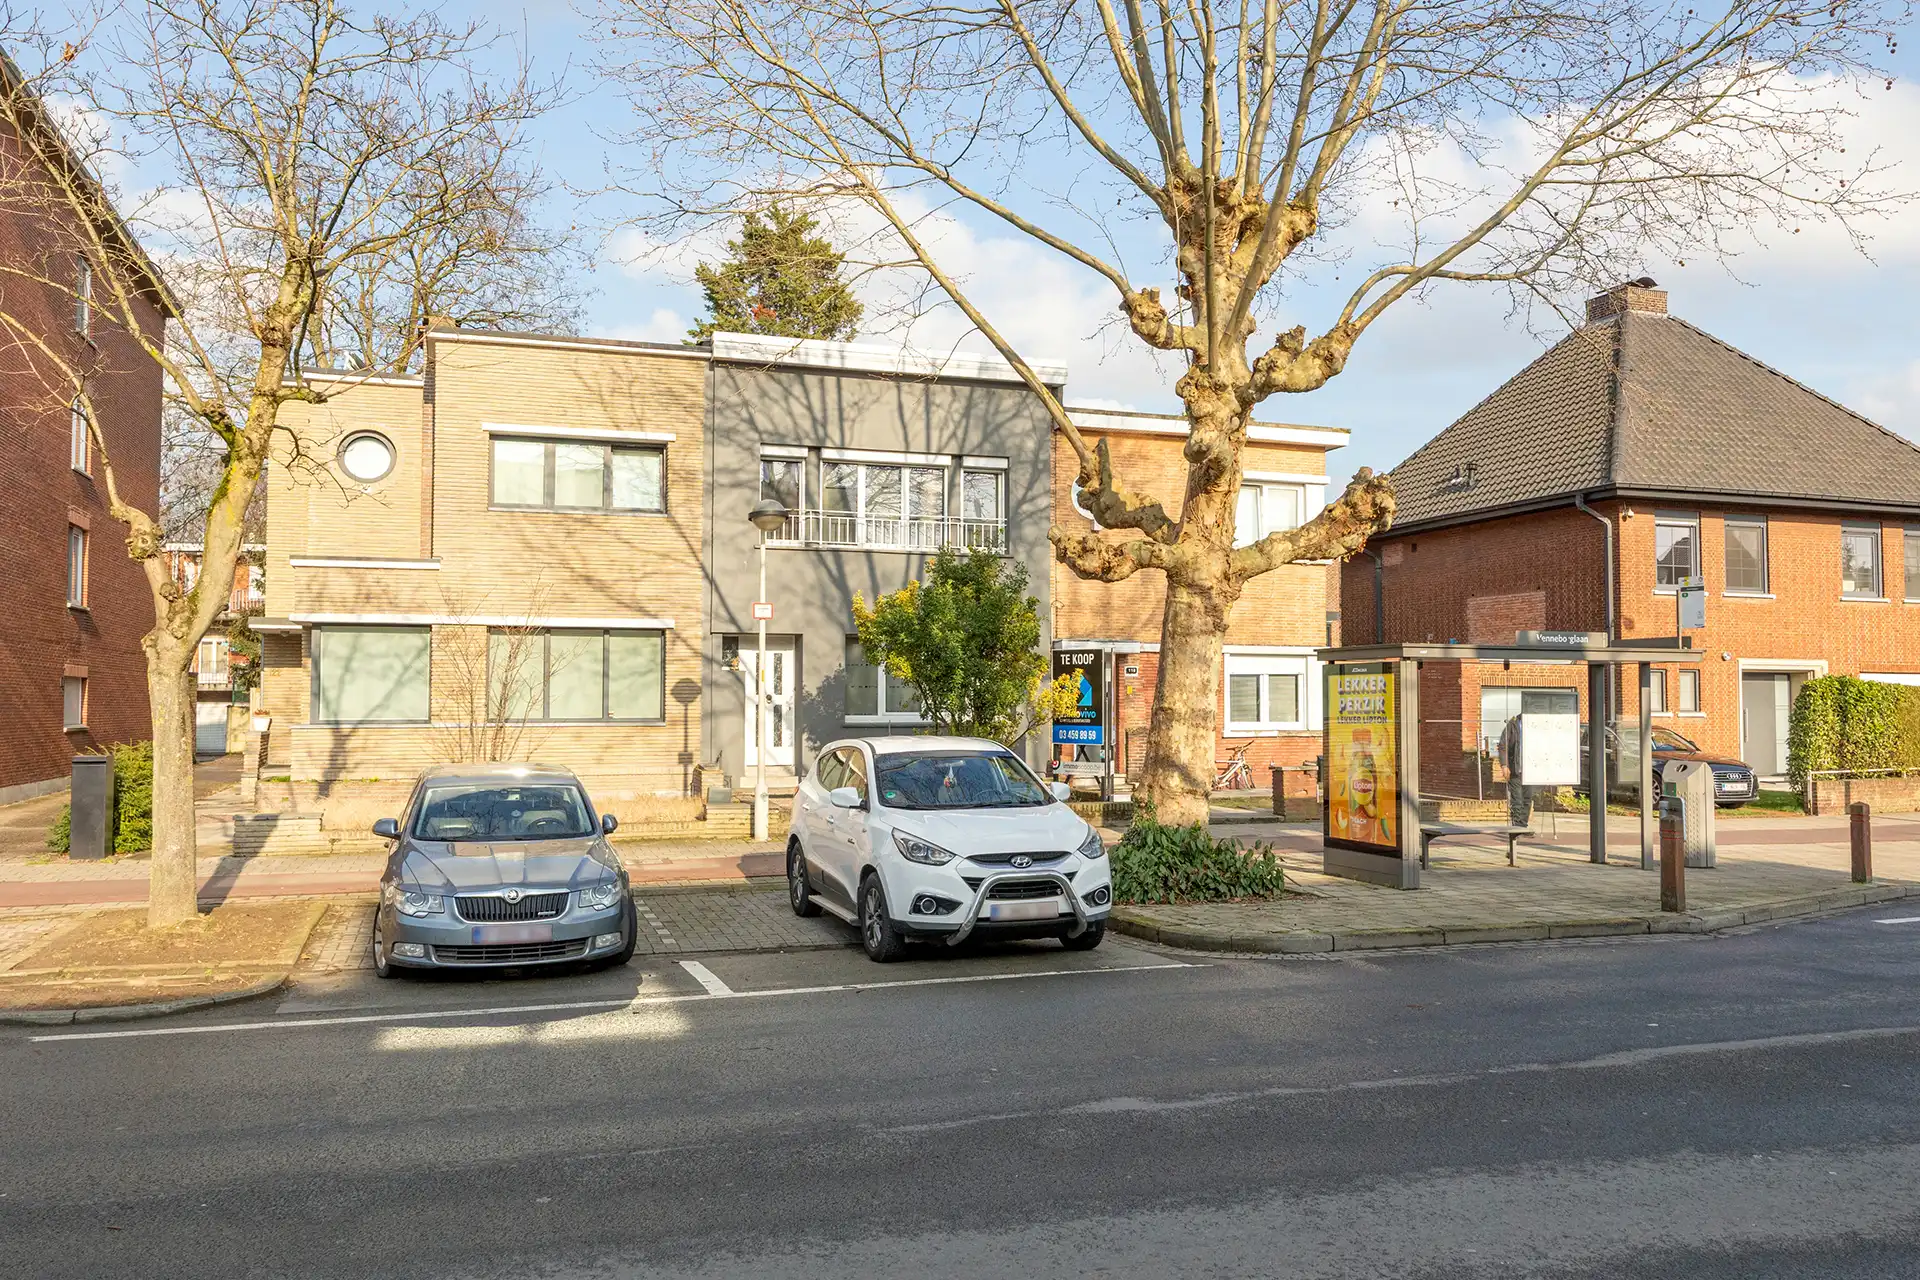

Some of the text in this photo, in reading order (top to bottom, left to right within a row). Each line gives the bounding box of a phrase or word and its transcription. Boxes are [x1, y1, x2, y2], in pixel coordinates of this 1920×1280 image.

[1060, 653, 1095, 665] TE KOOP
[1337, 676, 1387, 694] LEKKER
[1338, 696, 1386, 714] PERZIK
[1337, 715, 1387, 724] LEKKER LIPTON
[1058, 730, 1067, 740] 03
[1067, 730, 1079, 740] 459
